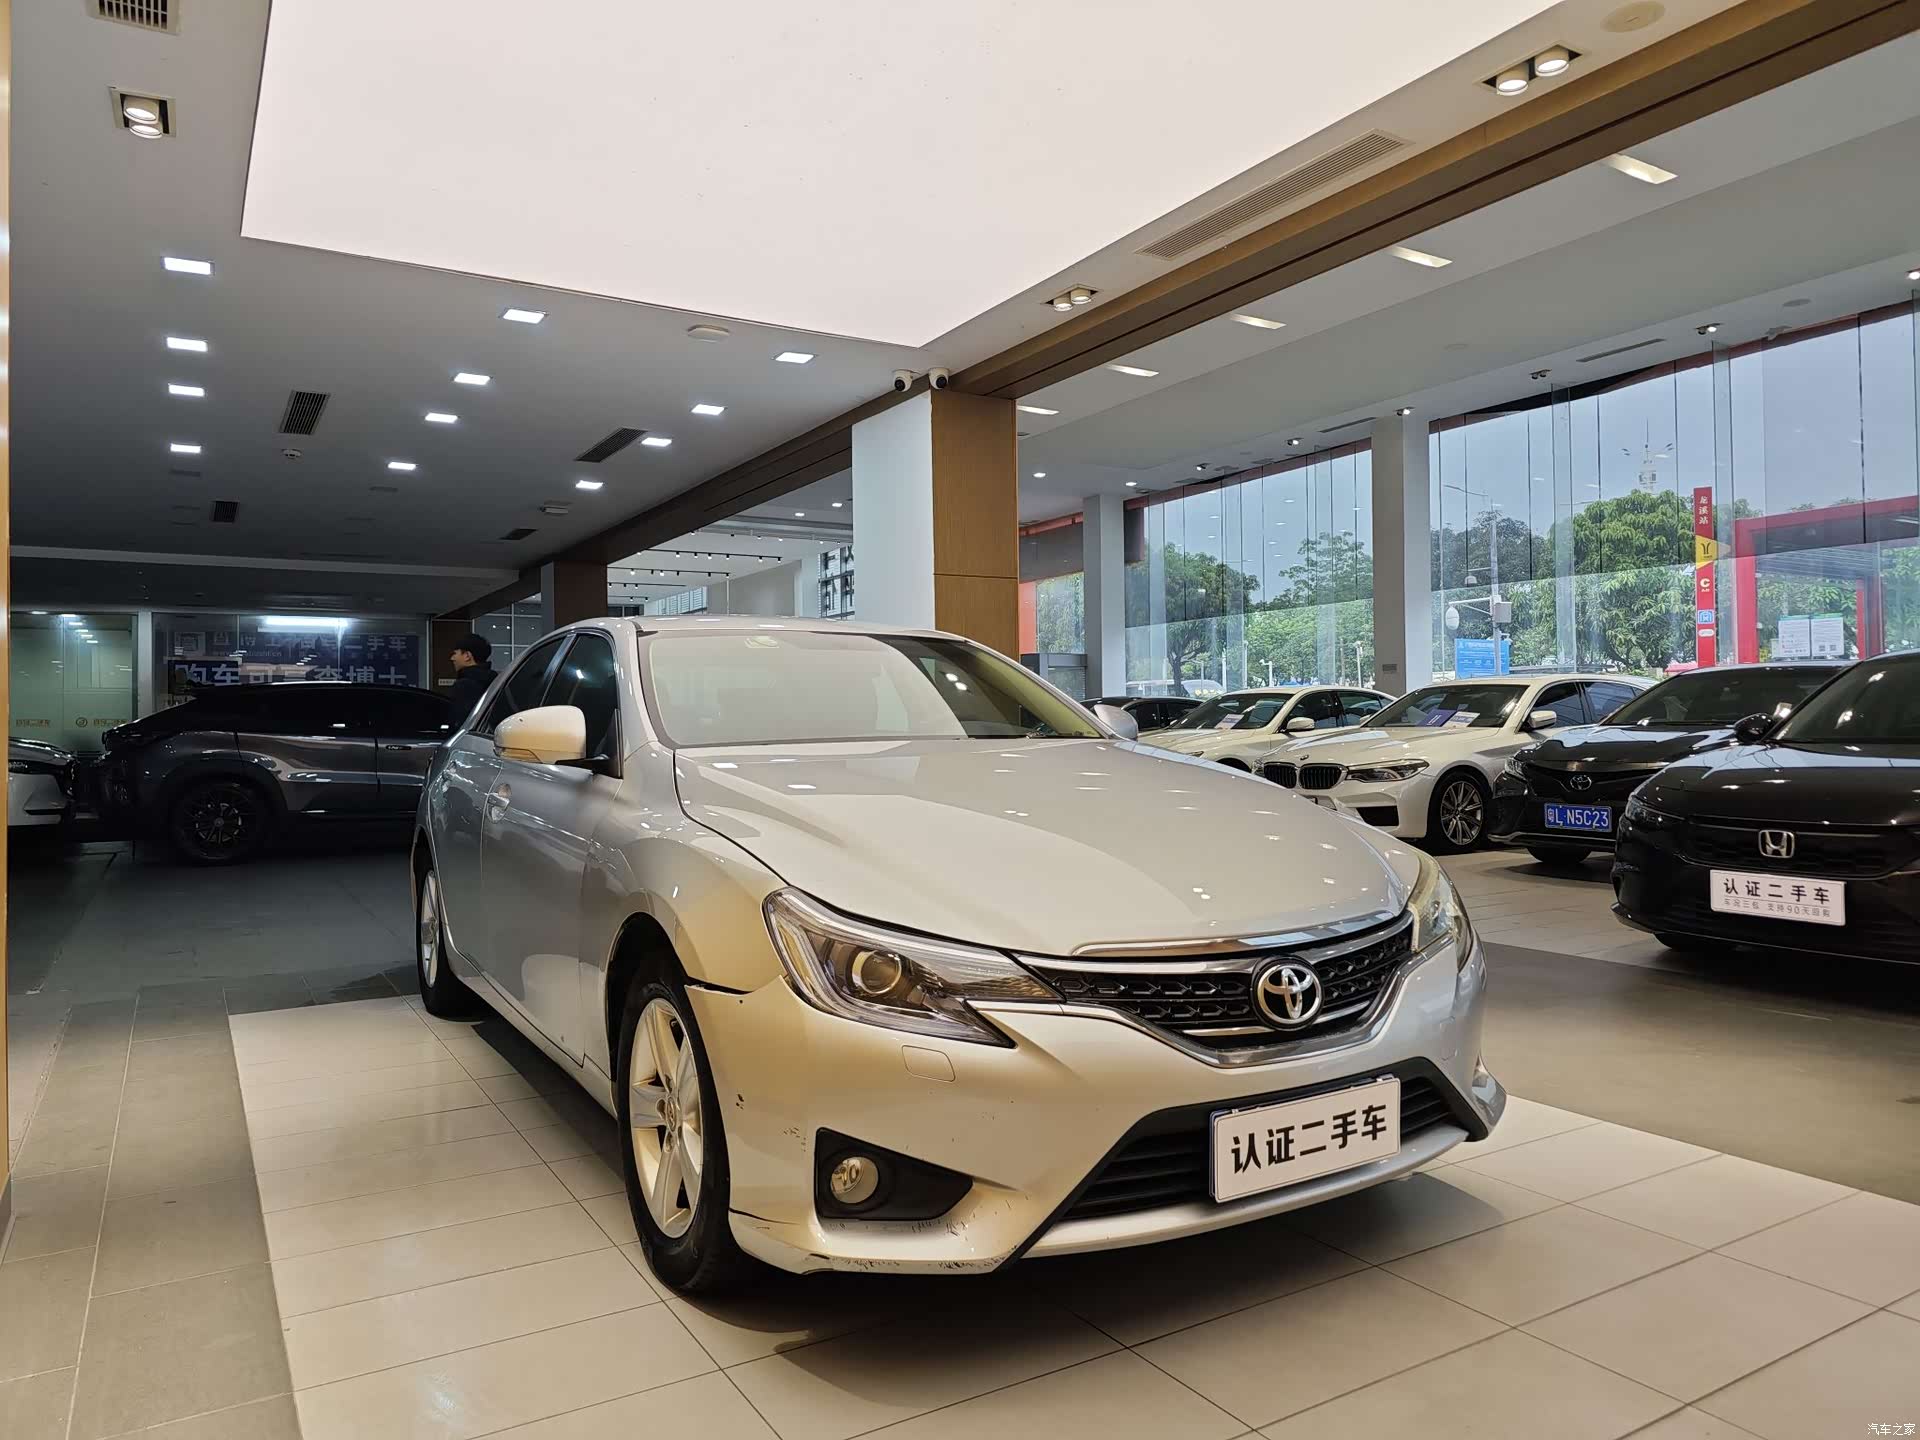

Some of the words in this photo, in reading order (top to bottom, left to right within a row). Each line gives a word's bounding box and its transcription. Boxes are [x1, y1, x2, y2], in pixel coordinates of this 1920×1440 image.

[1700, 578, 1710, 588] C
[1723, 878, 1830, 904] 认证二手车
[1231, 1104, 1387, 1174] 认证二手车
